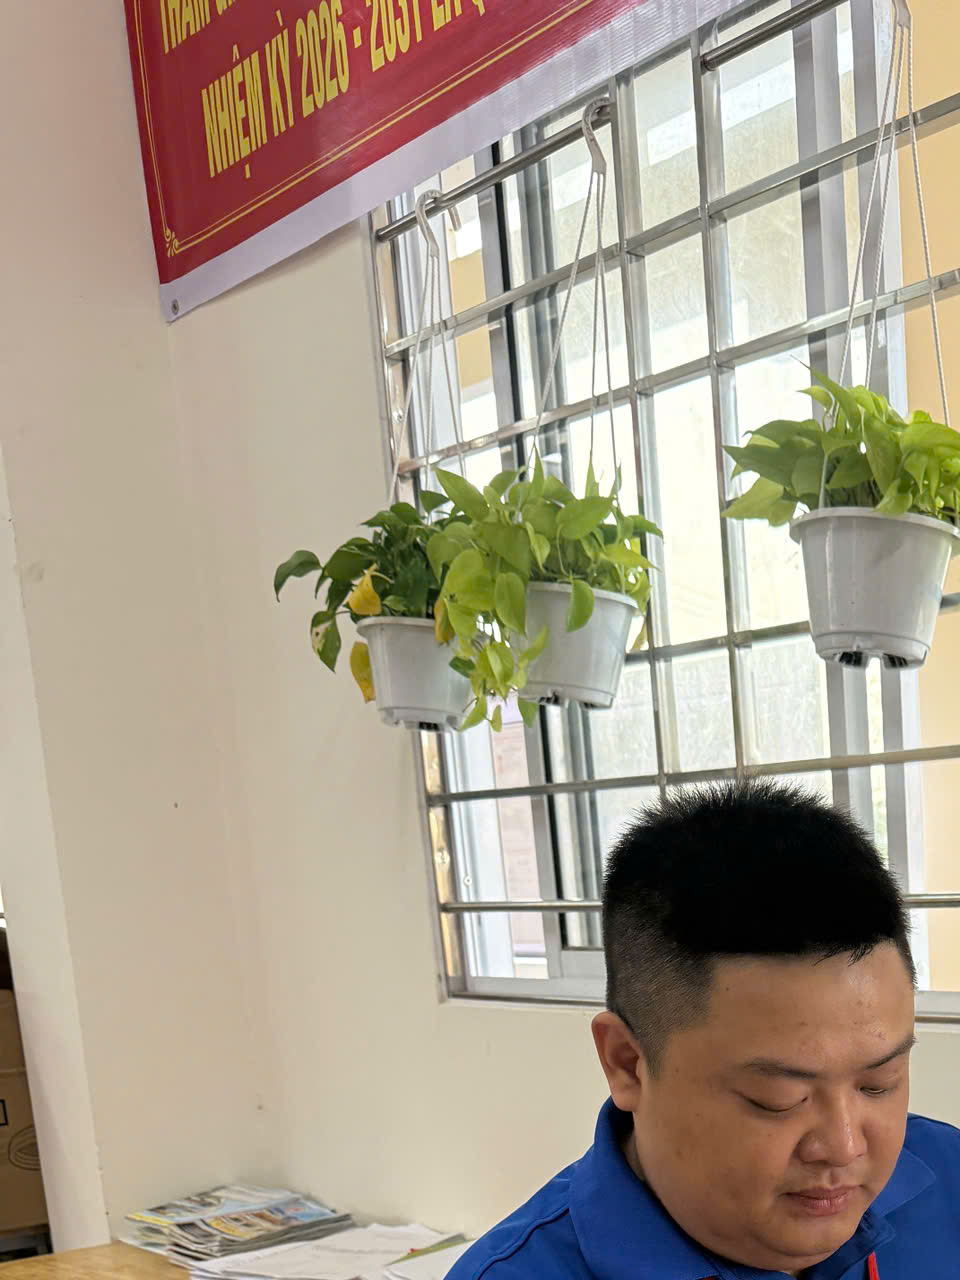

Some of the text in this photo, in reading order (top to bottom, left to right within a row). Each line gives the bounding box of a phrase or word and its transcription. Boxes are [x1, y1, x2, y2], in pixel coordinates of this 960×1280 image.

[201, 44, 268, 179] NHIỆM
[265, 10, 295, 137] KỲ
[295, 0, 350, 118] 2026
